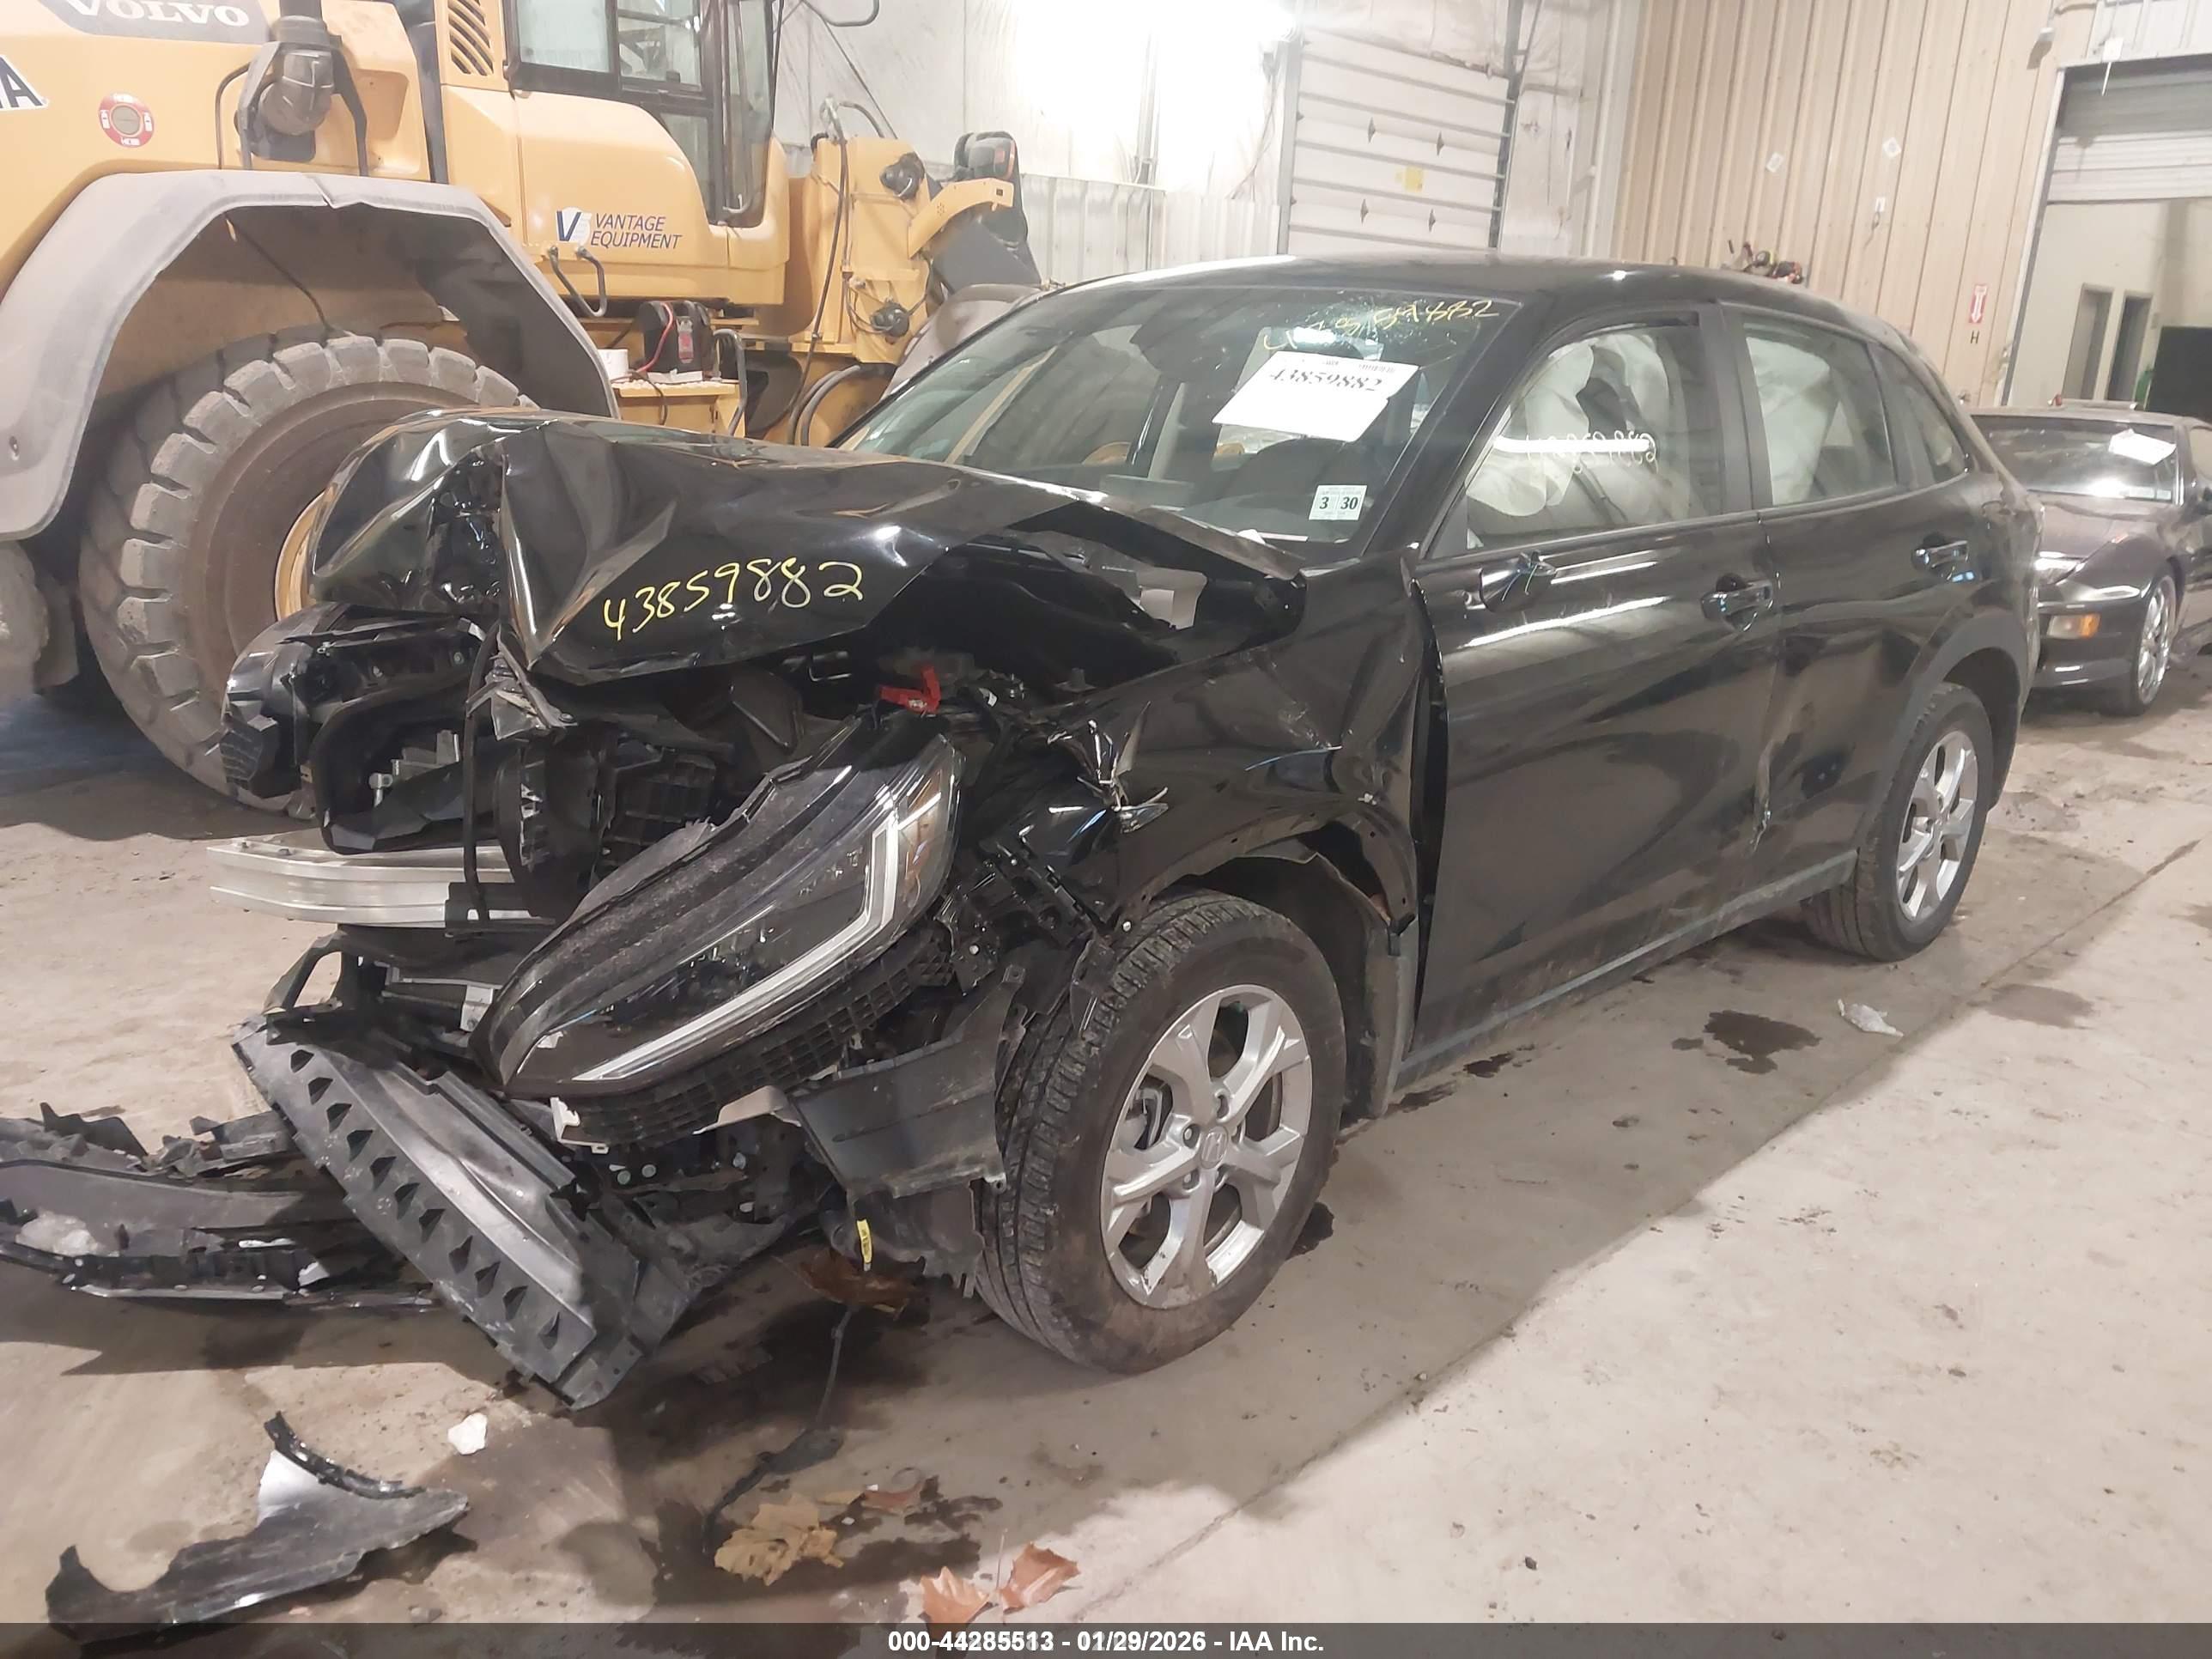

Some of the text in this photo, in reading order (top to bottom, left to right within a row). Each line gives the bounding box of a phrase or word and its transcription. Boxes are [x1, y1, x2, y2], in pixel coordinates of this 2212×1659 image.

[66, 0, 250, 27] VOLVO
[595, 213, 666, 232] VANTAGE
[590, 230, 683, 249] EQUIPMENT
[1319, 496, 1358, 510] 3 30
[604, 557, 863, 641] 43859882
